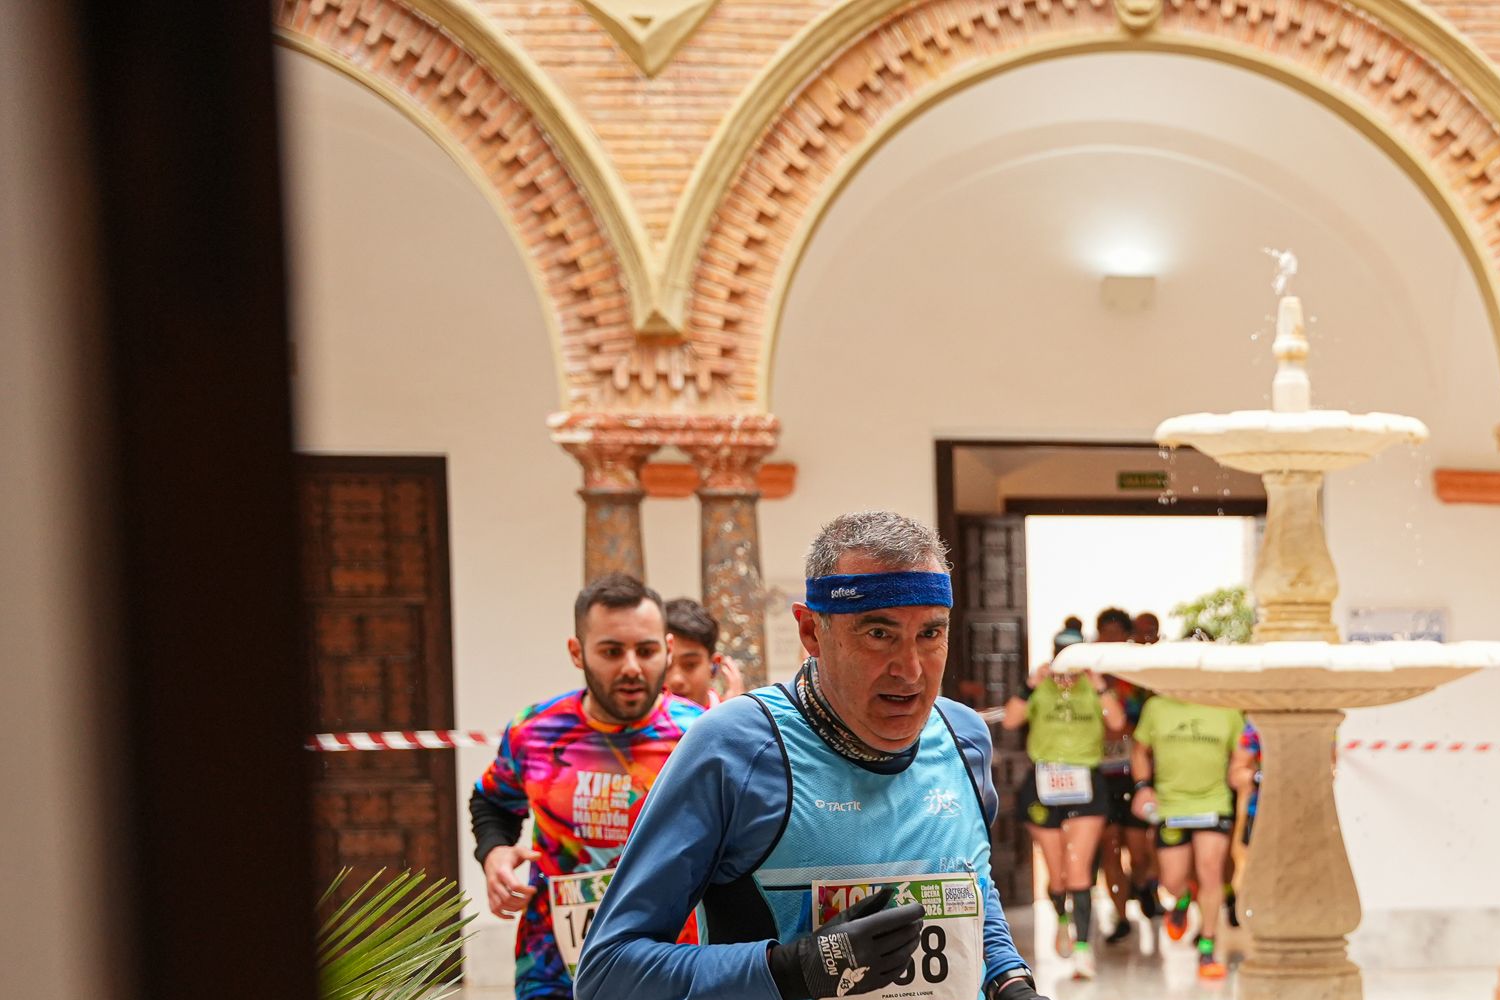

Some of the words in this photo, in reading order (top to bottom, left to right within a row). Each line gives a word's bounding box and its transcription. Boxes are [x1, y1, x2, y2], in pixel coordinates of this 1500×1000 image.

[830, 587, 857, 599] softee
[826, 800, 861, 811] TACTIC
[945, 886, 970, 895] carreras
[945, 892, 974, 902] populares
[828, 933, 843, 959] SAN
[819, 935, 839, 976] ANTÓN
[840, 978, 851, 990] 43
